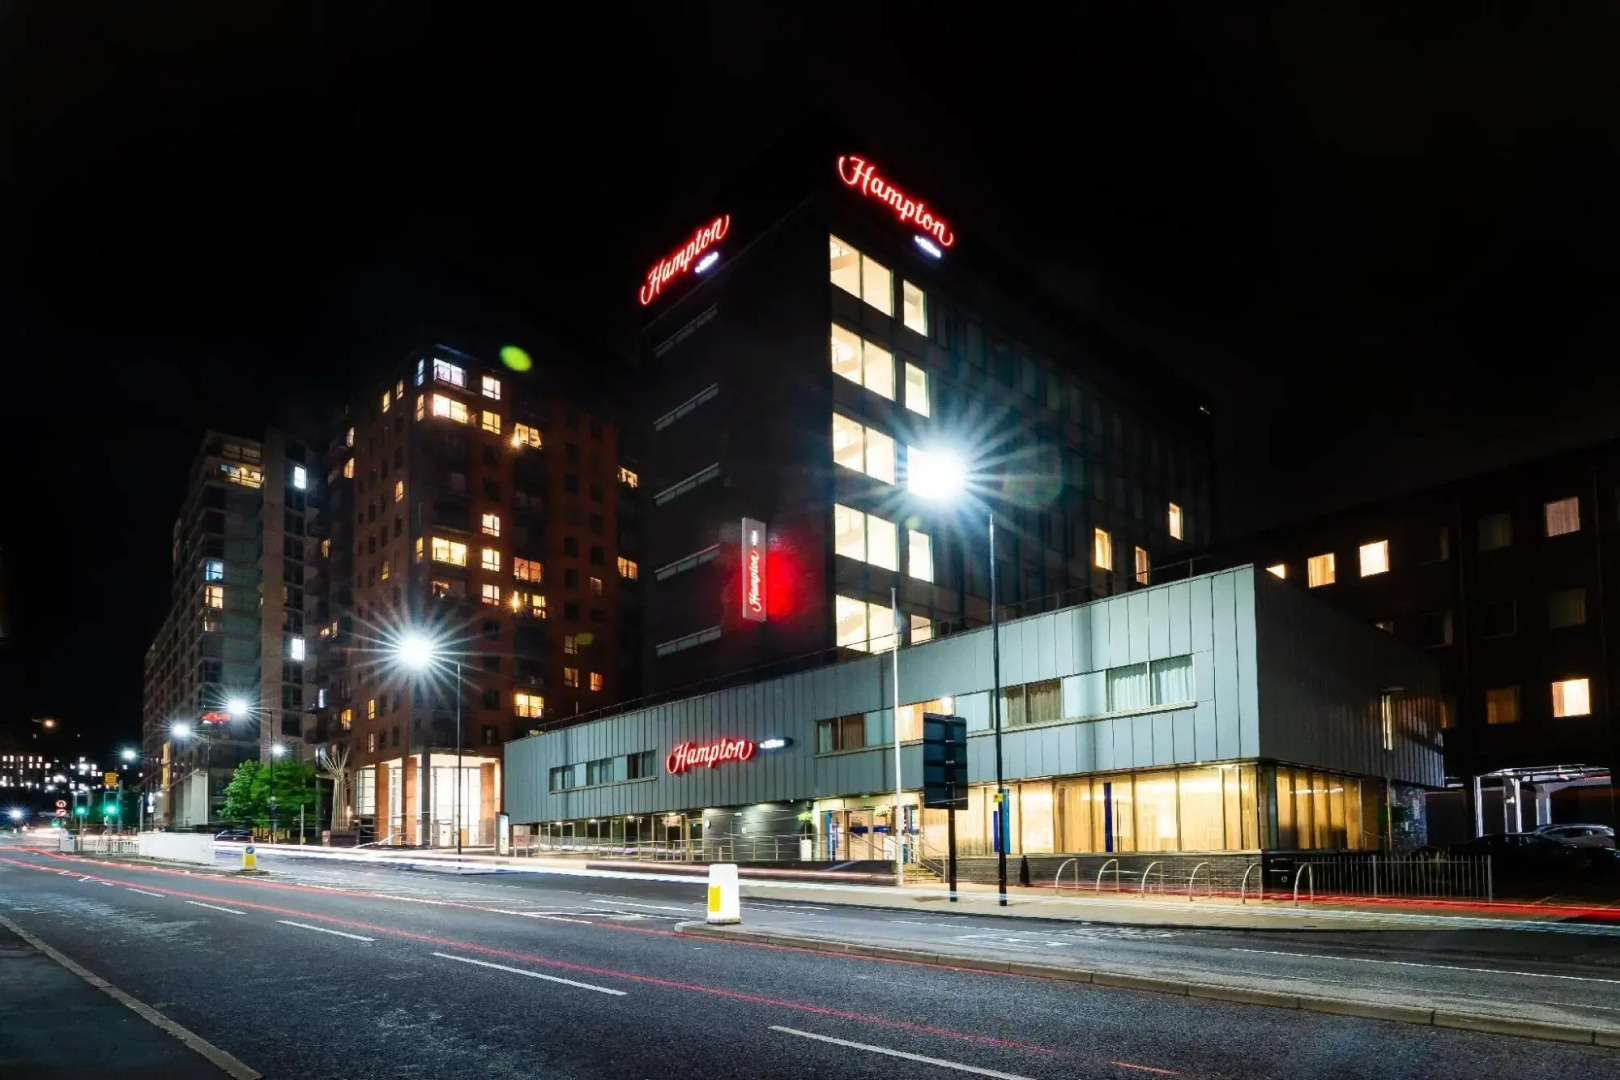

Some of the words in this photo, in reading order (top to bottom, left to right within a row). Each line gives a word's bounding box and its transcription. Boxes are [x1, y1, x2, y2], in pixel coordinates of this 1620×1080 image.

[838, 156, 954, 246] Hampton
[641, 215, 730, 305] Hampton
[749, 550, 762, 612] Hampton
[666, 738, 753, 774] Hampton
